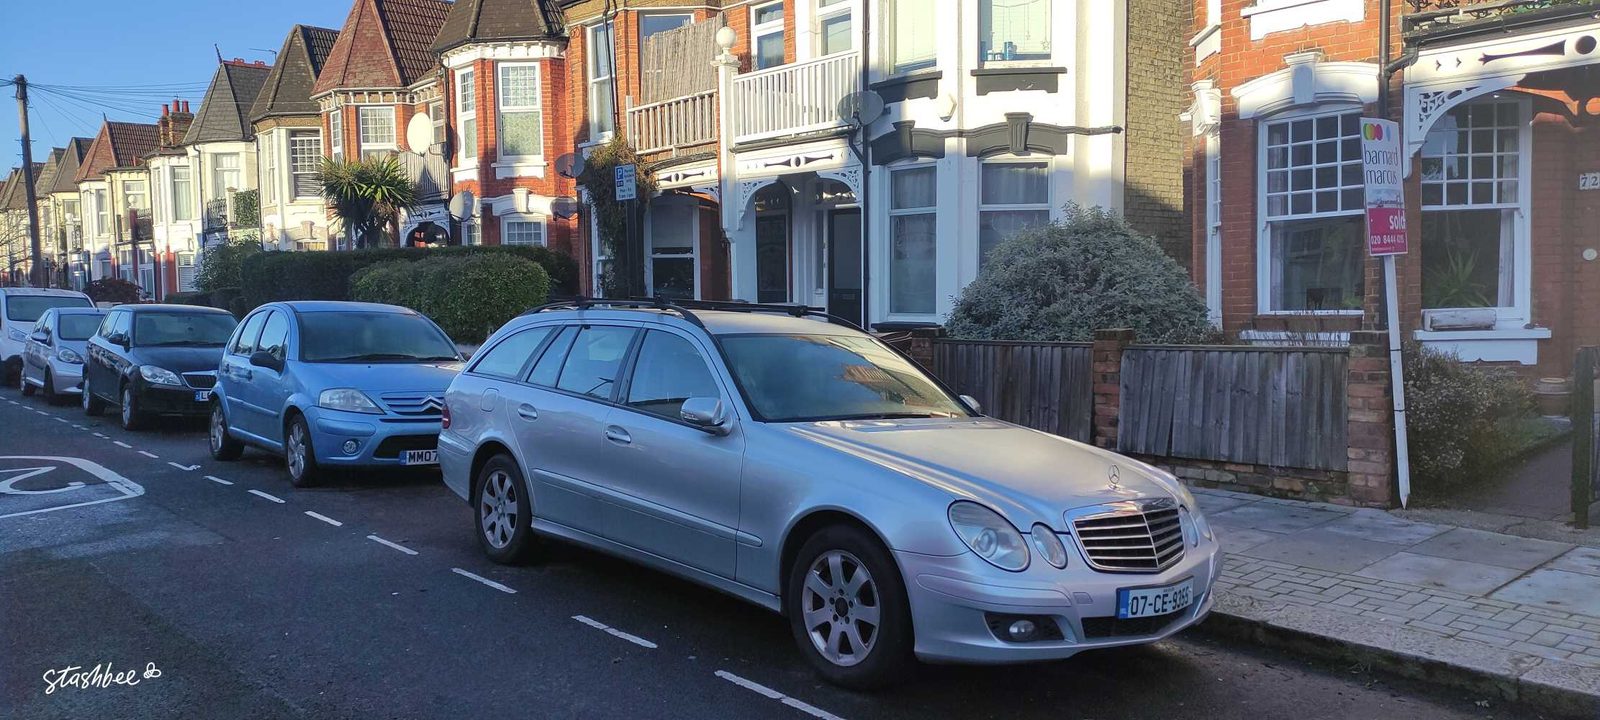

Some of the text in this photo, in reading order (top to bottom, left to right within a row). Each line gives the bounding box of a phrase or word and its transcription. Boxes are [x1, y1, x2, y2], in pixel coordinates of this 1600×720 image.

[1364, 144, 1399, 166] barnard
[1365, 169, 1398, 185] marcus
[1581, 176, 1598, 187] 72
[1389, 210, 1406, 230] sold
[408, 451, 438, 463] MM07
